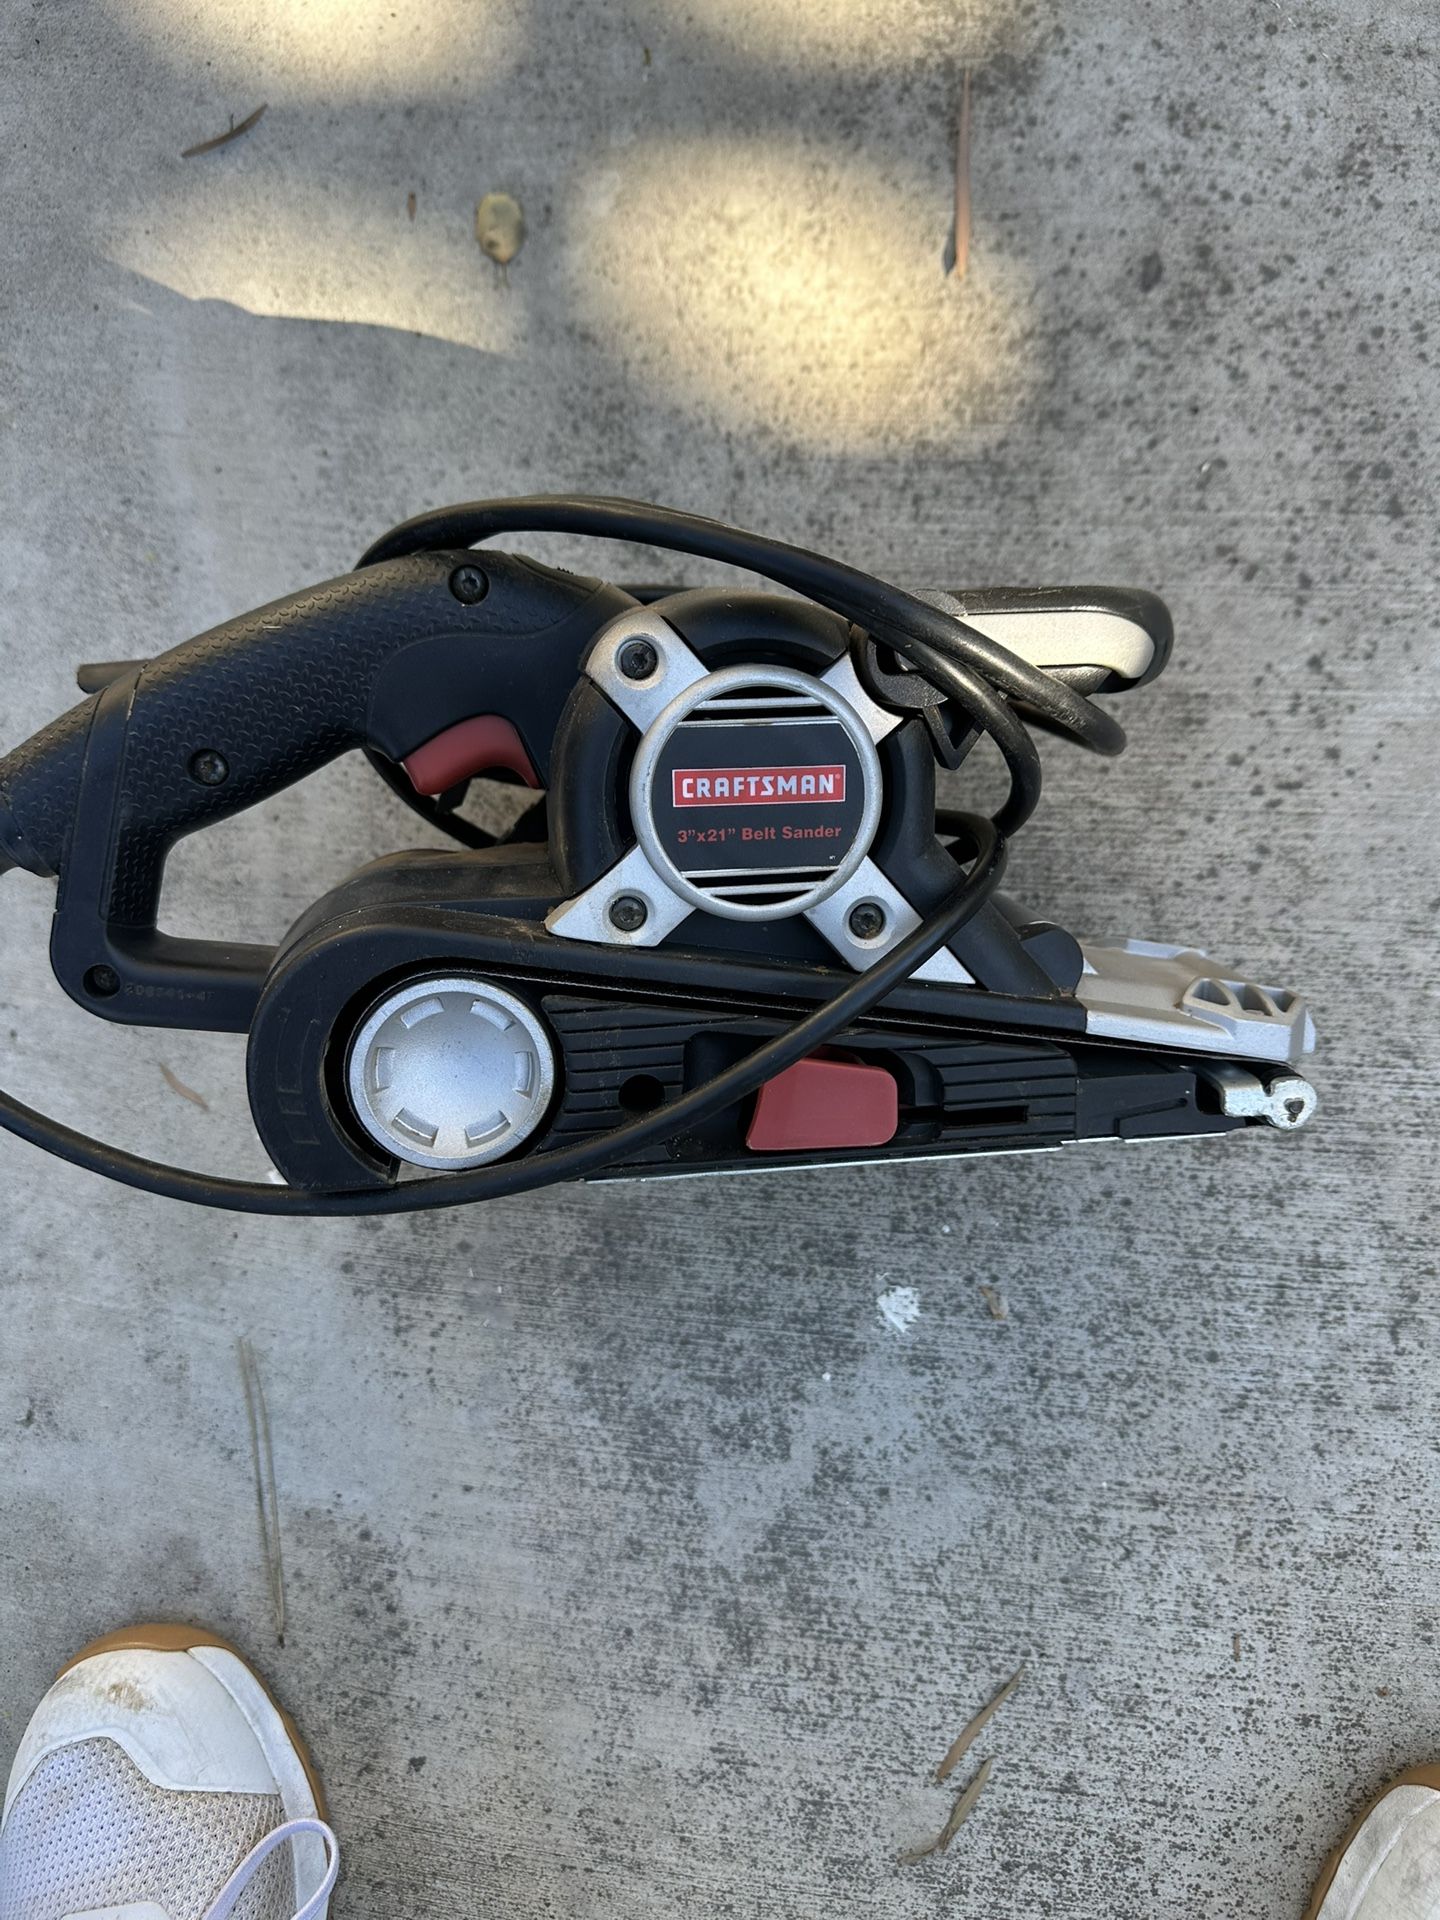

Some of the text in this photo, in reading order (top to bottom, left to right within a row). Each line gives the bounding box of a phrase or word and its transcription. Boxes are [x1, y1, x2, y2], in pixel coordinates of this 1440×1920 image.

[682, 774, 834, 799] CRAFTSMAN
[741, 826, 776, 841] Belt
[782, 825, 842, 840] Sander
